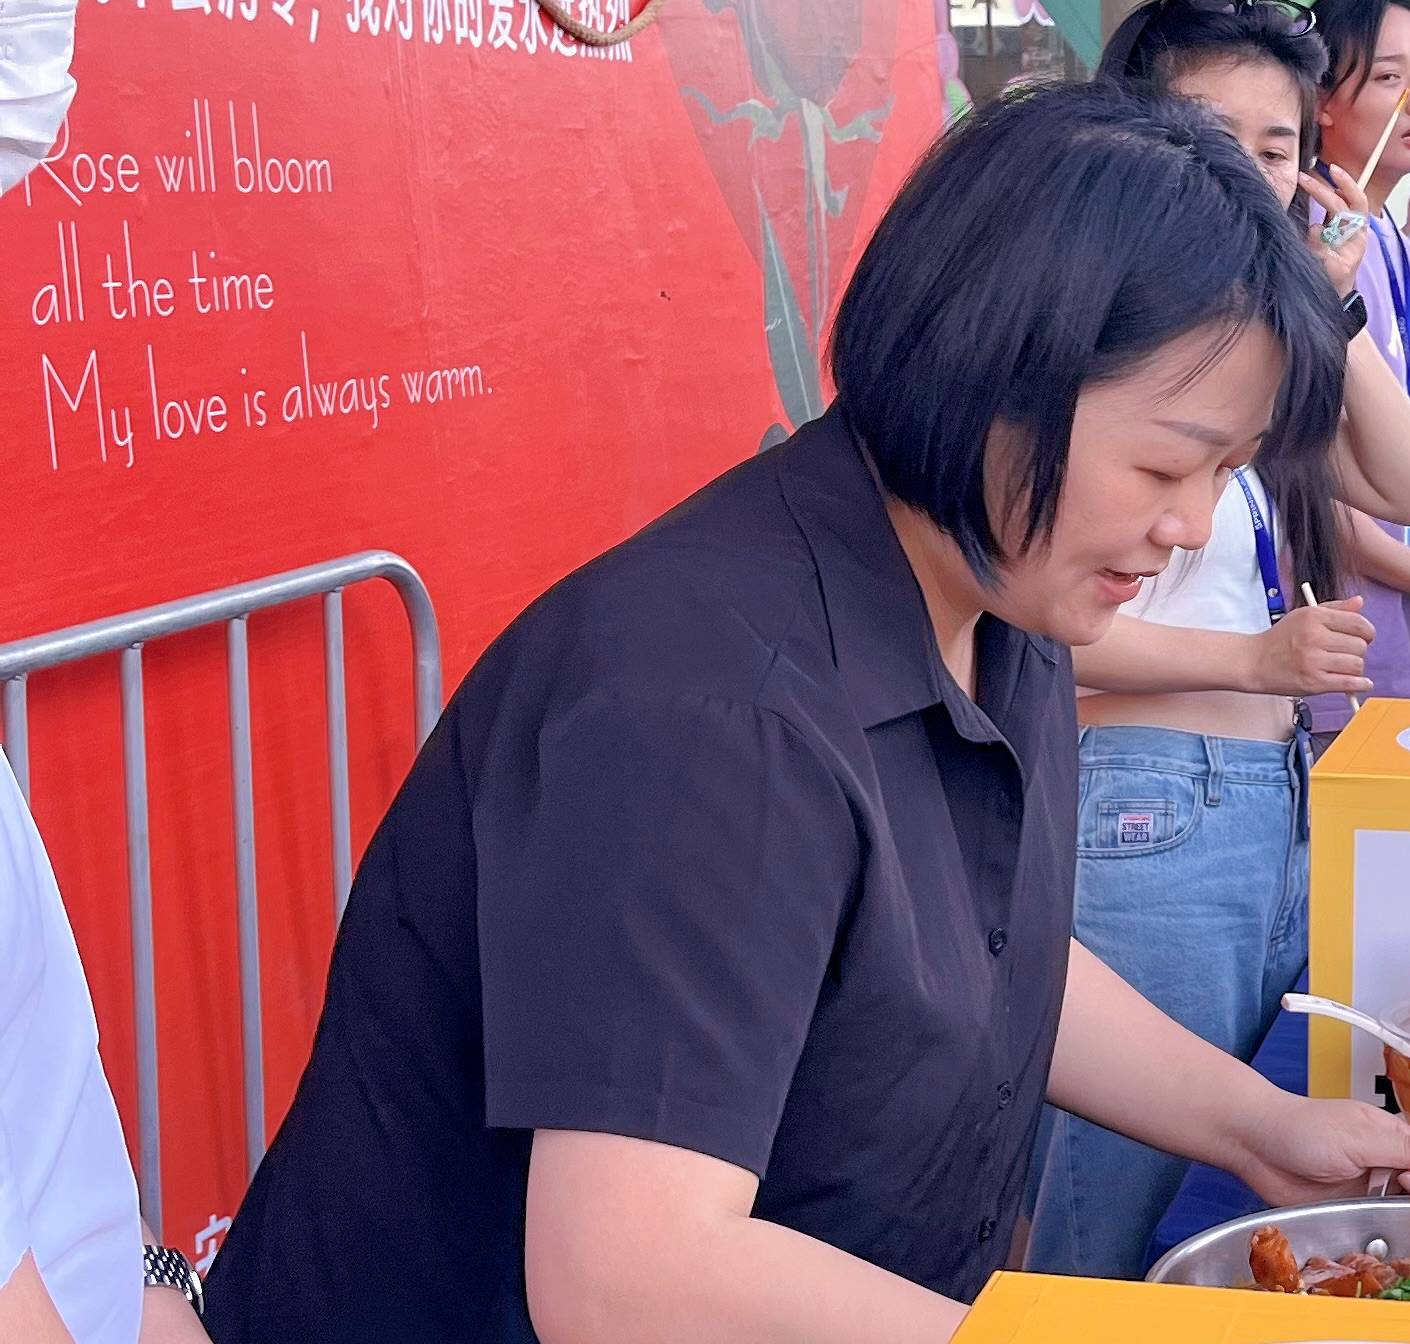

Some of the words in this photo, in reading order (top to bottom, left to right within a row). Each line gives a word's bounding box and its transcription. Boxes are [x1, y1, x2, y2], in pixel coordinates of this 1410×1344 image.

[154, 97, 217, 194] will
[228, 99, 333, 194] bloom
[31, 220, 86, 326] all
[101, 219, 175, 321] the
[188, 249, 275, 314] time
[41, 348, 136, 471] My
[147, 343, 229, 441] love
[240, 367, 268, 428] is
[281, 329, 392, 430] always
[399, 363, 495, 406] warm.
